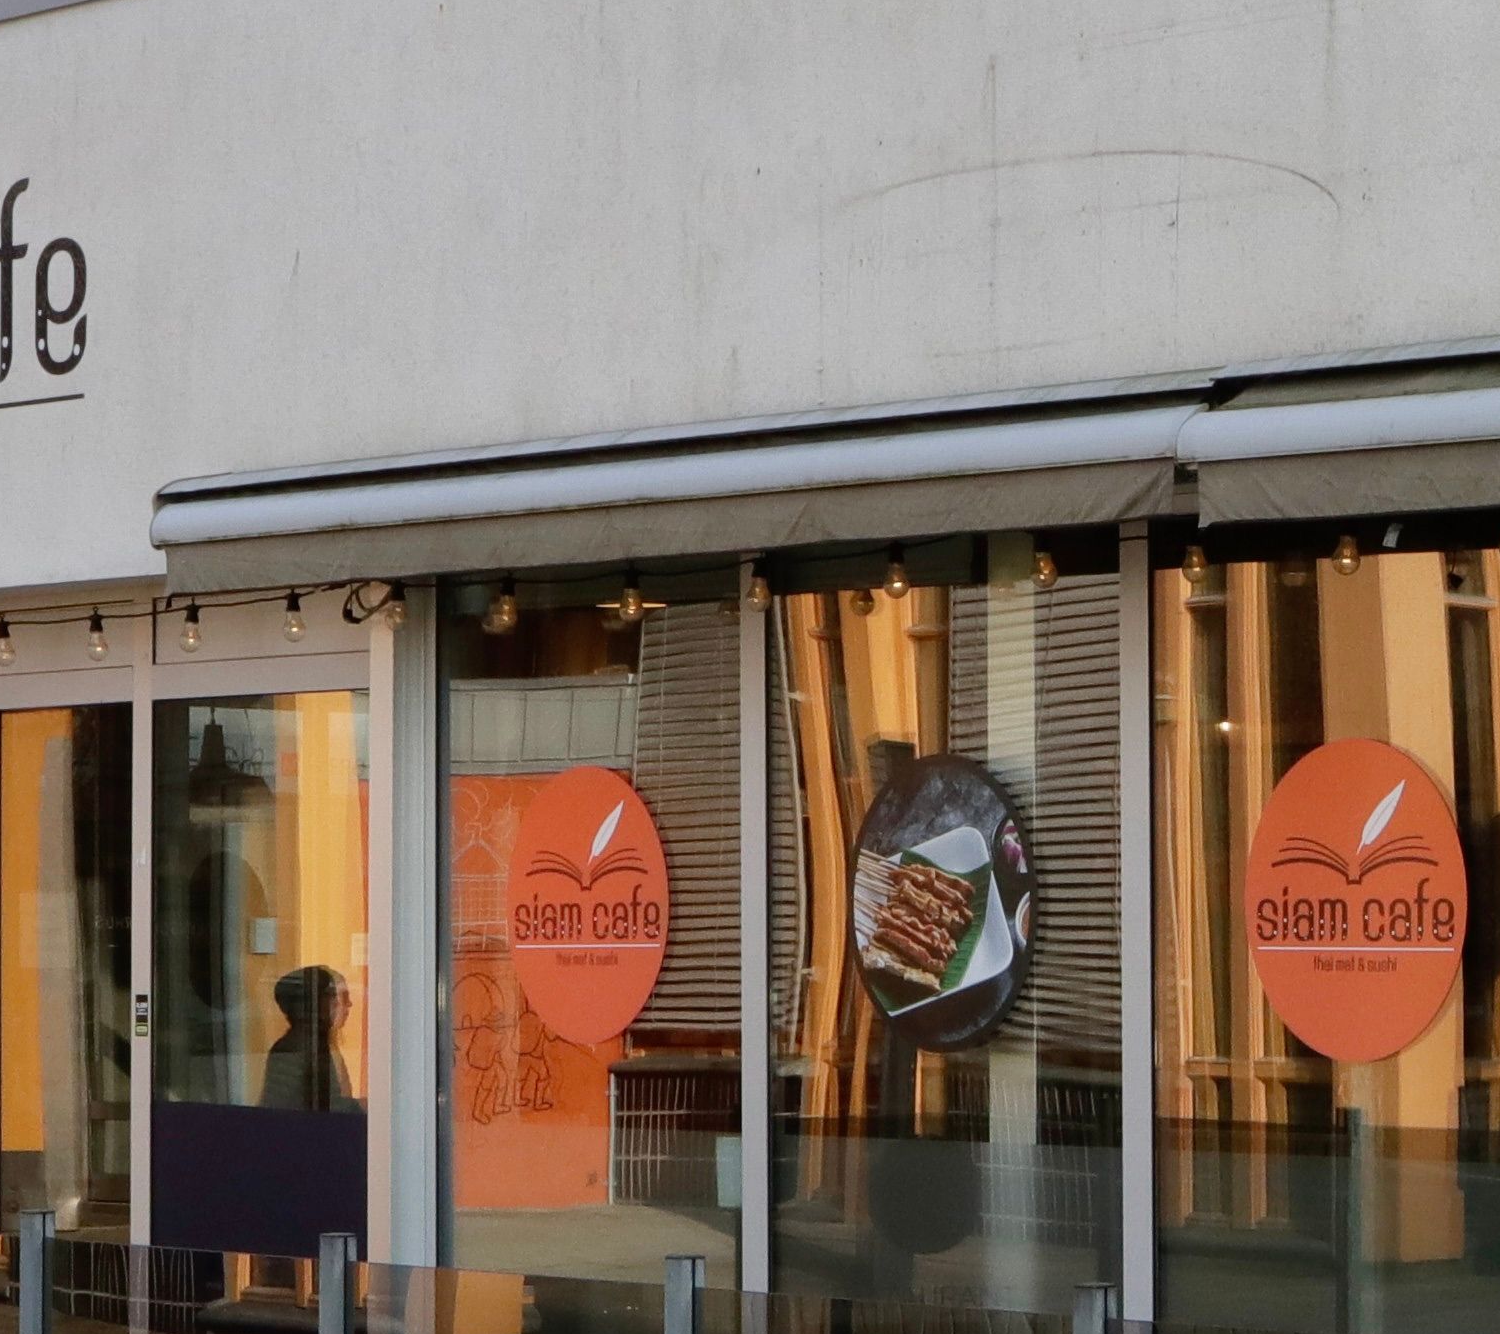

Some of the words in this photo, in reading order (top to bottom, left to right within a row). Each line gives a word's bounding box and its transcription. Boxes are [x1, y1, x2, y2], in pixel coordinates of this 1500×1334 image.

[514, 892, 583, 942] siam
[591, 883, 661, 941] cafe
[1255, 885, 1349, 942] siam
[1362, 876, 1456, 943] cafe
